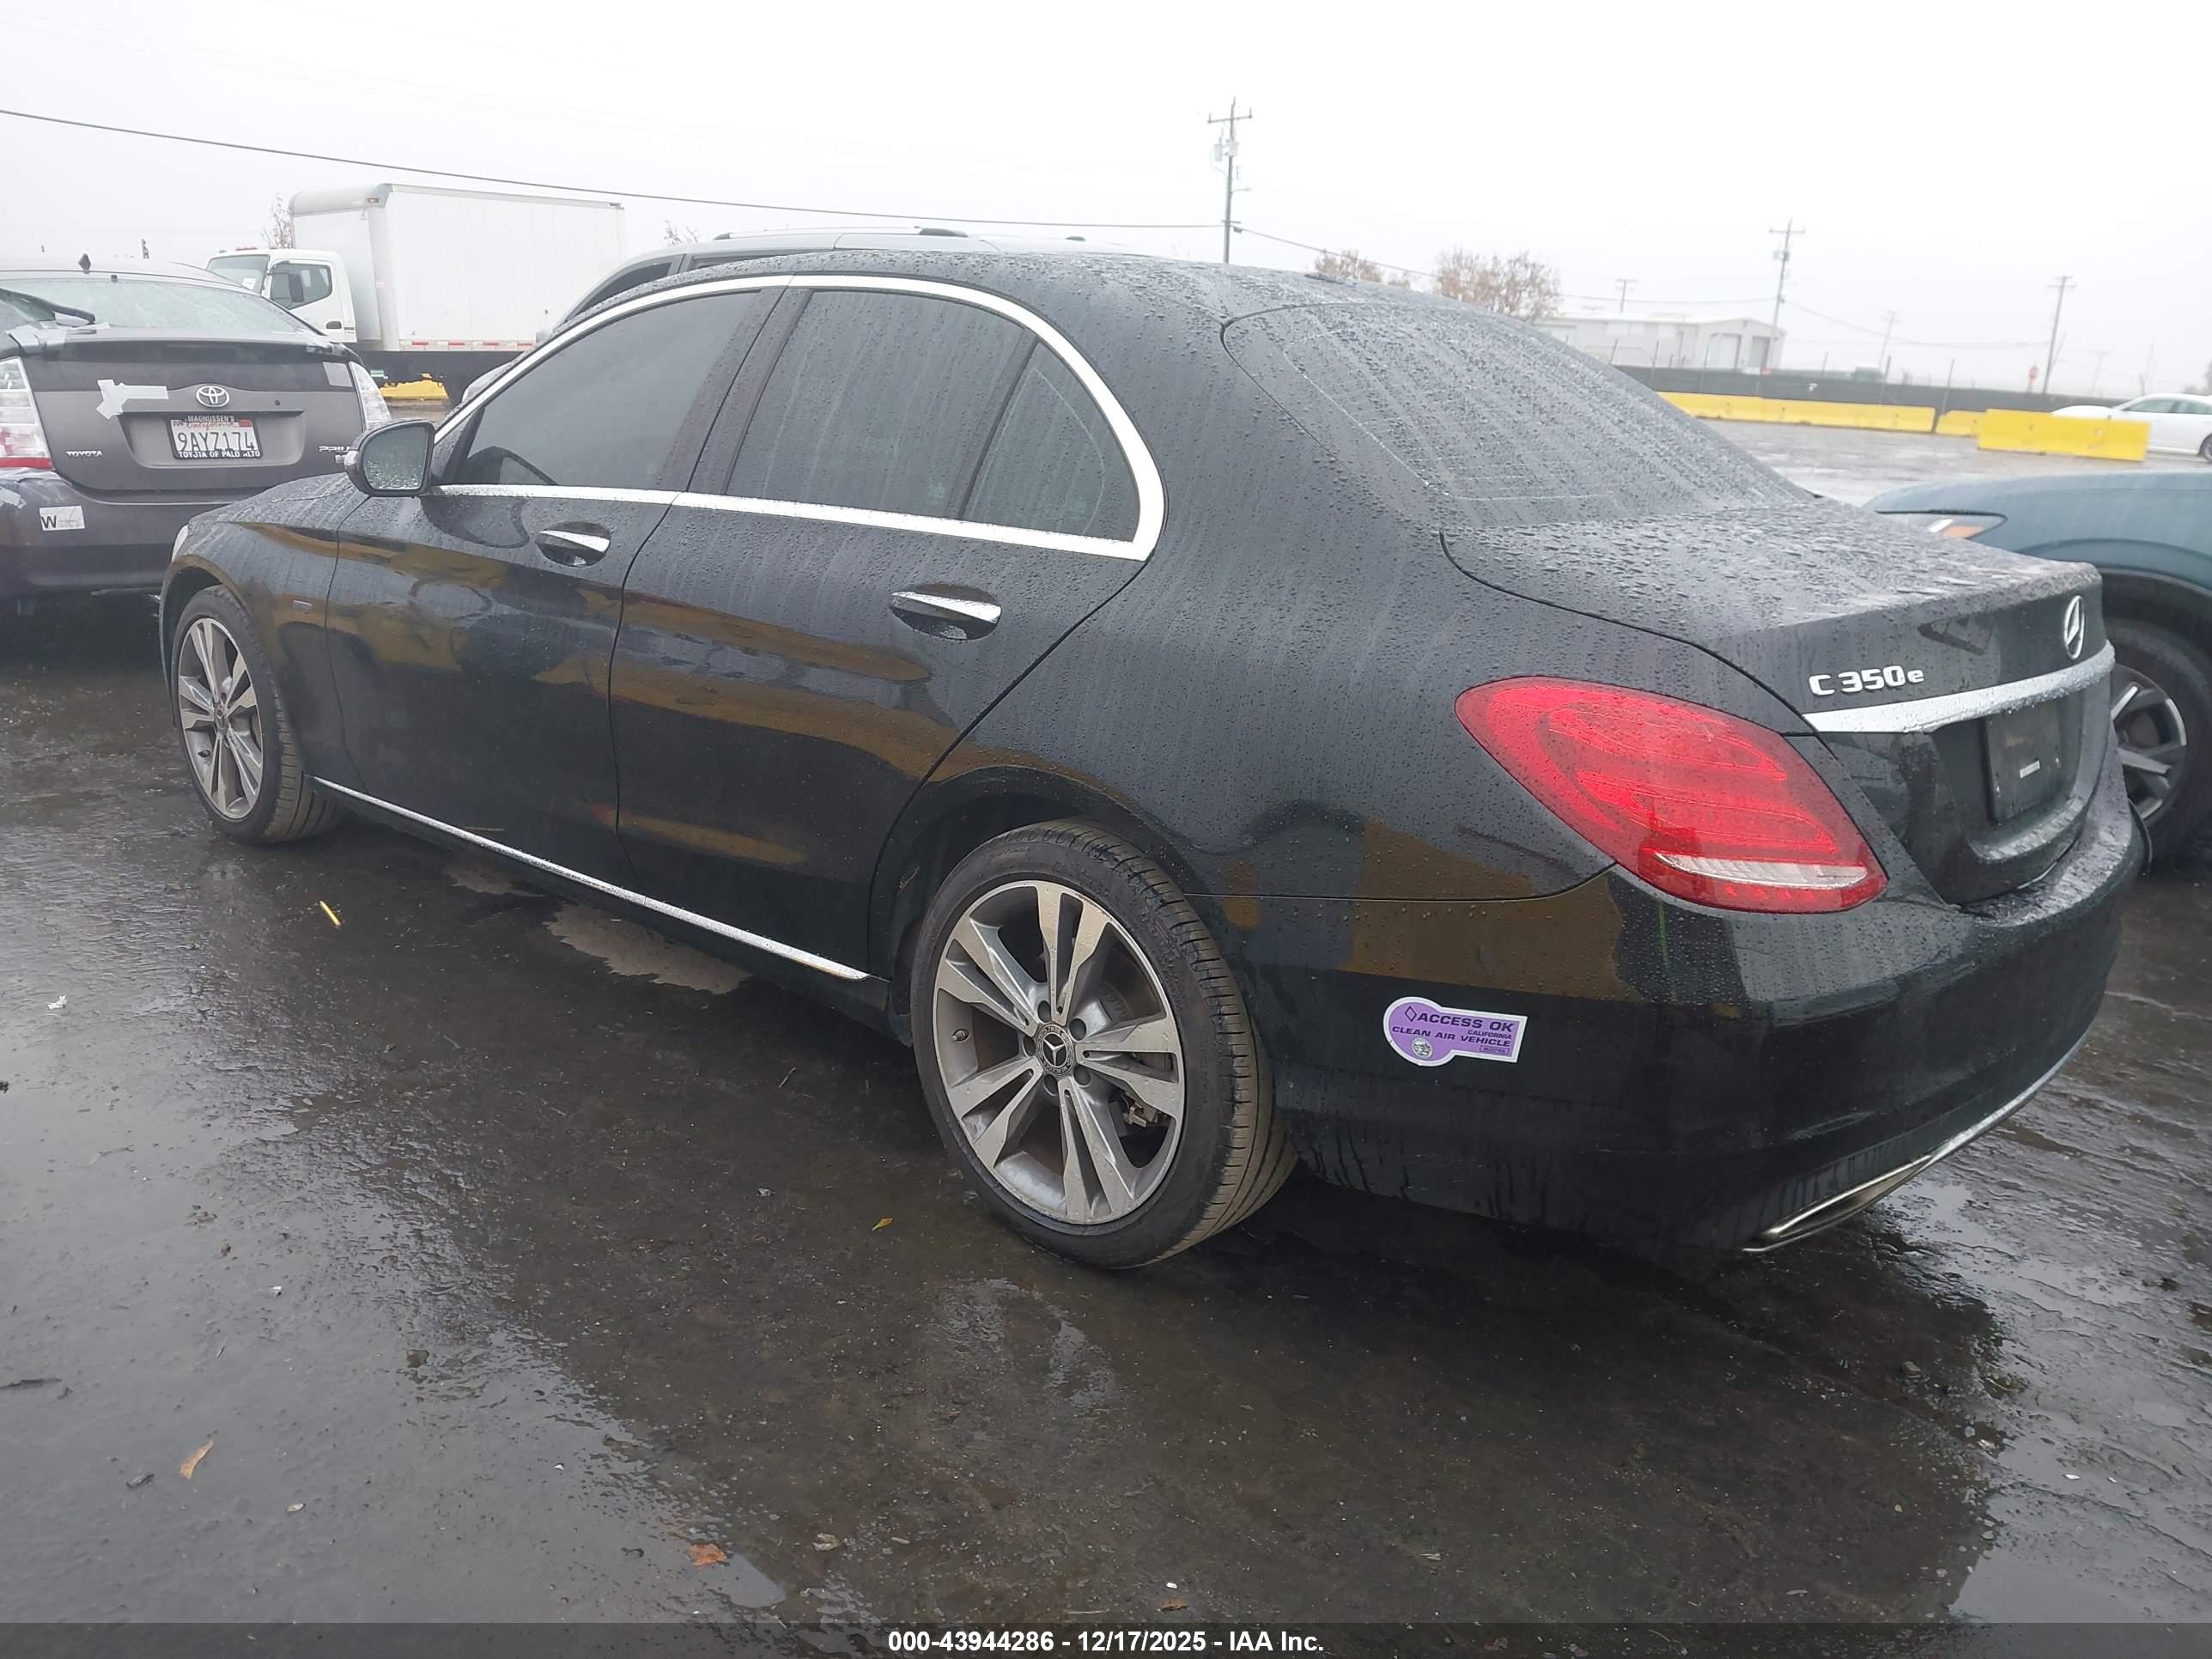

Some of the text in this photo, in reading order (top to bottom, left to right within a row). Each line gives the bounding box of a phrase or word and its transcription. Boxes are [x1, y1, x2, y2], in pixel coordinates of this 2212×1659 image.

[41, 514, 57, 529] W
[1808, 674, 1835, 696] C
[1417, 1012, 1515, 1033] ACCESS OK
[1392, 1025, 1511, 1048] CLEAN AIR VEHICLE
[1468, 1030, 1512, 1040] CALIFORNIA
